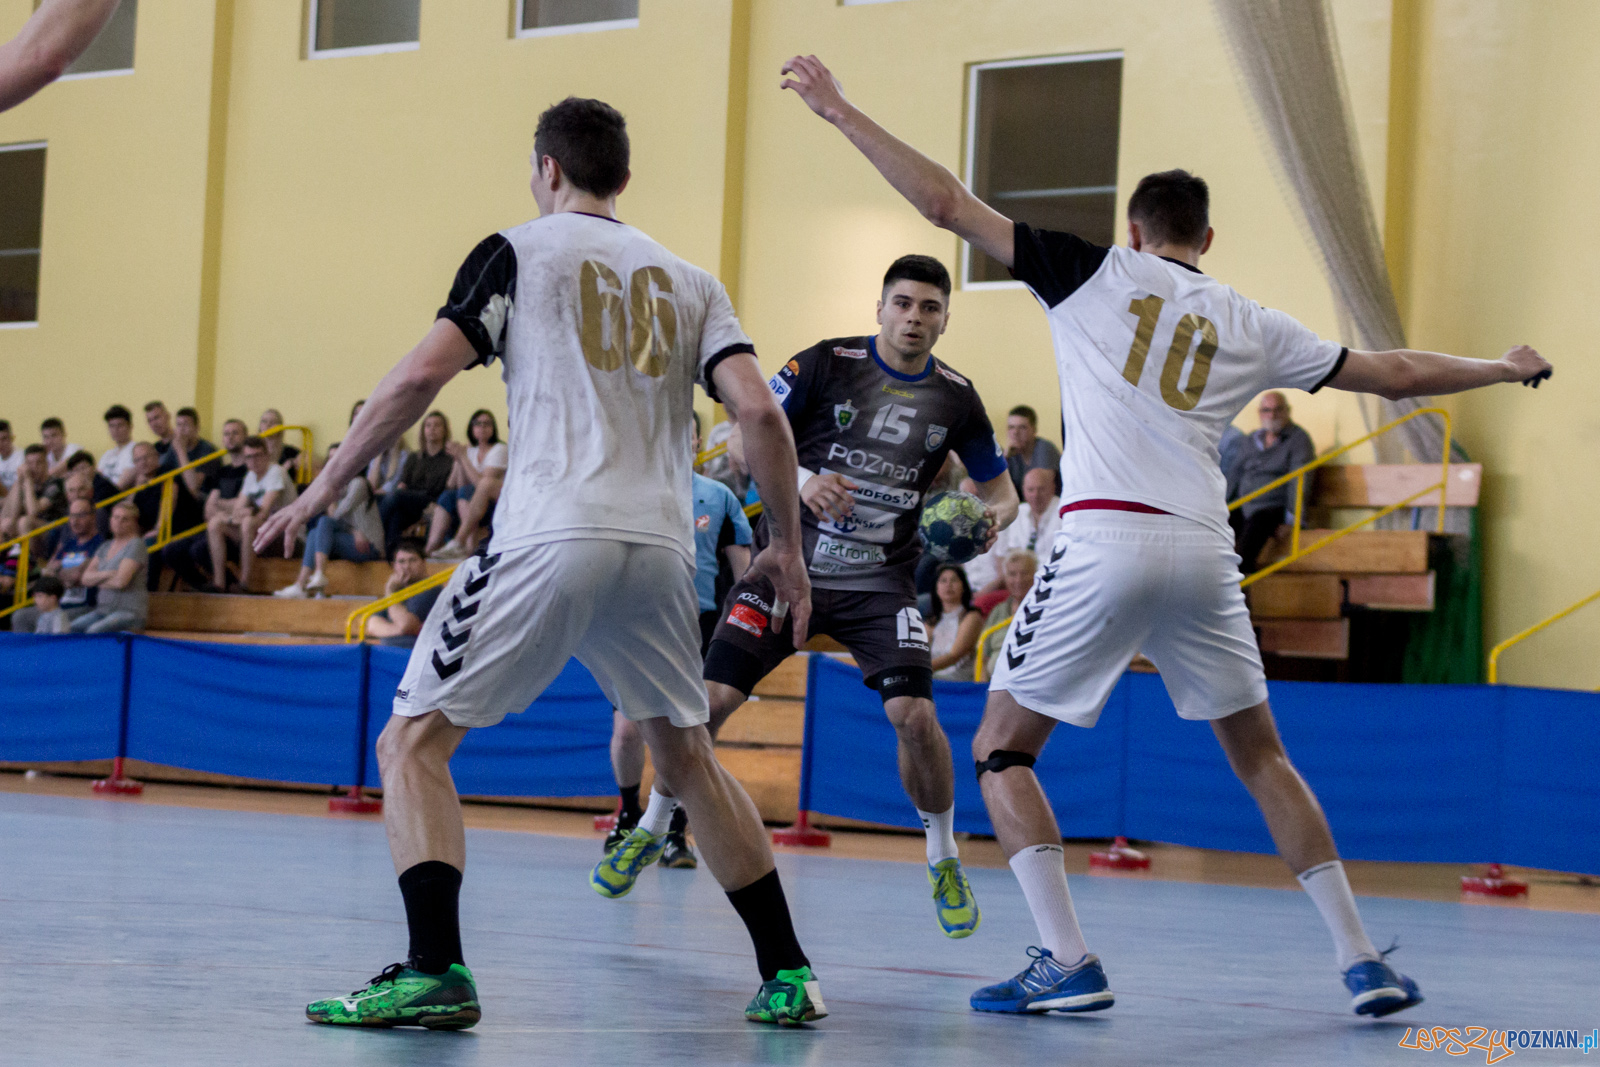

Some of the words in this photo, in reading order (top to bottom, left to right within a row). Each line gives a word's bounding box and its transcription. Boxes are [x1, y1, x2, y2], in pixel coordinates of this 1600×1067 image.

[580, 259, 677, 378] 66
[1121, 293, 1219, 411] 10
[867, 403, 918, 445] 15
[853, 487, 901, 503] NDFOS
[819, 541, 885, 561] netronik
[896, 606, 929, 643] 15
